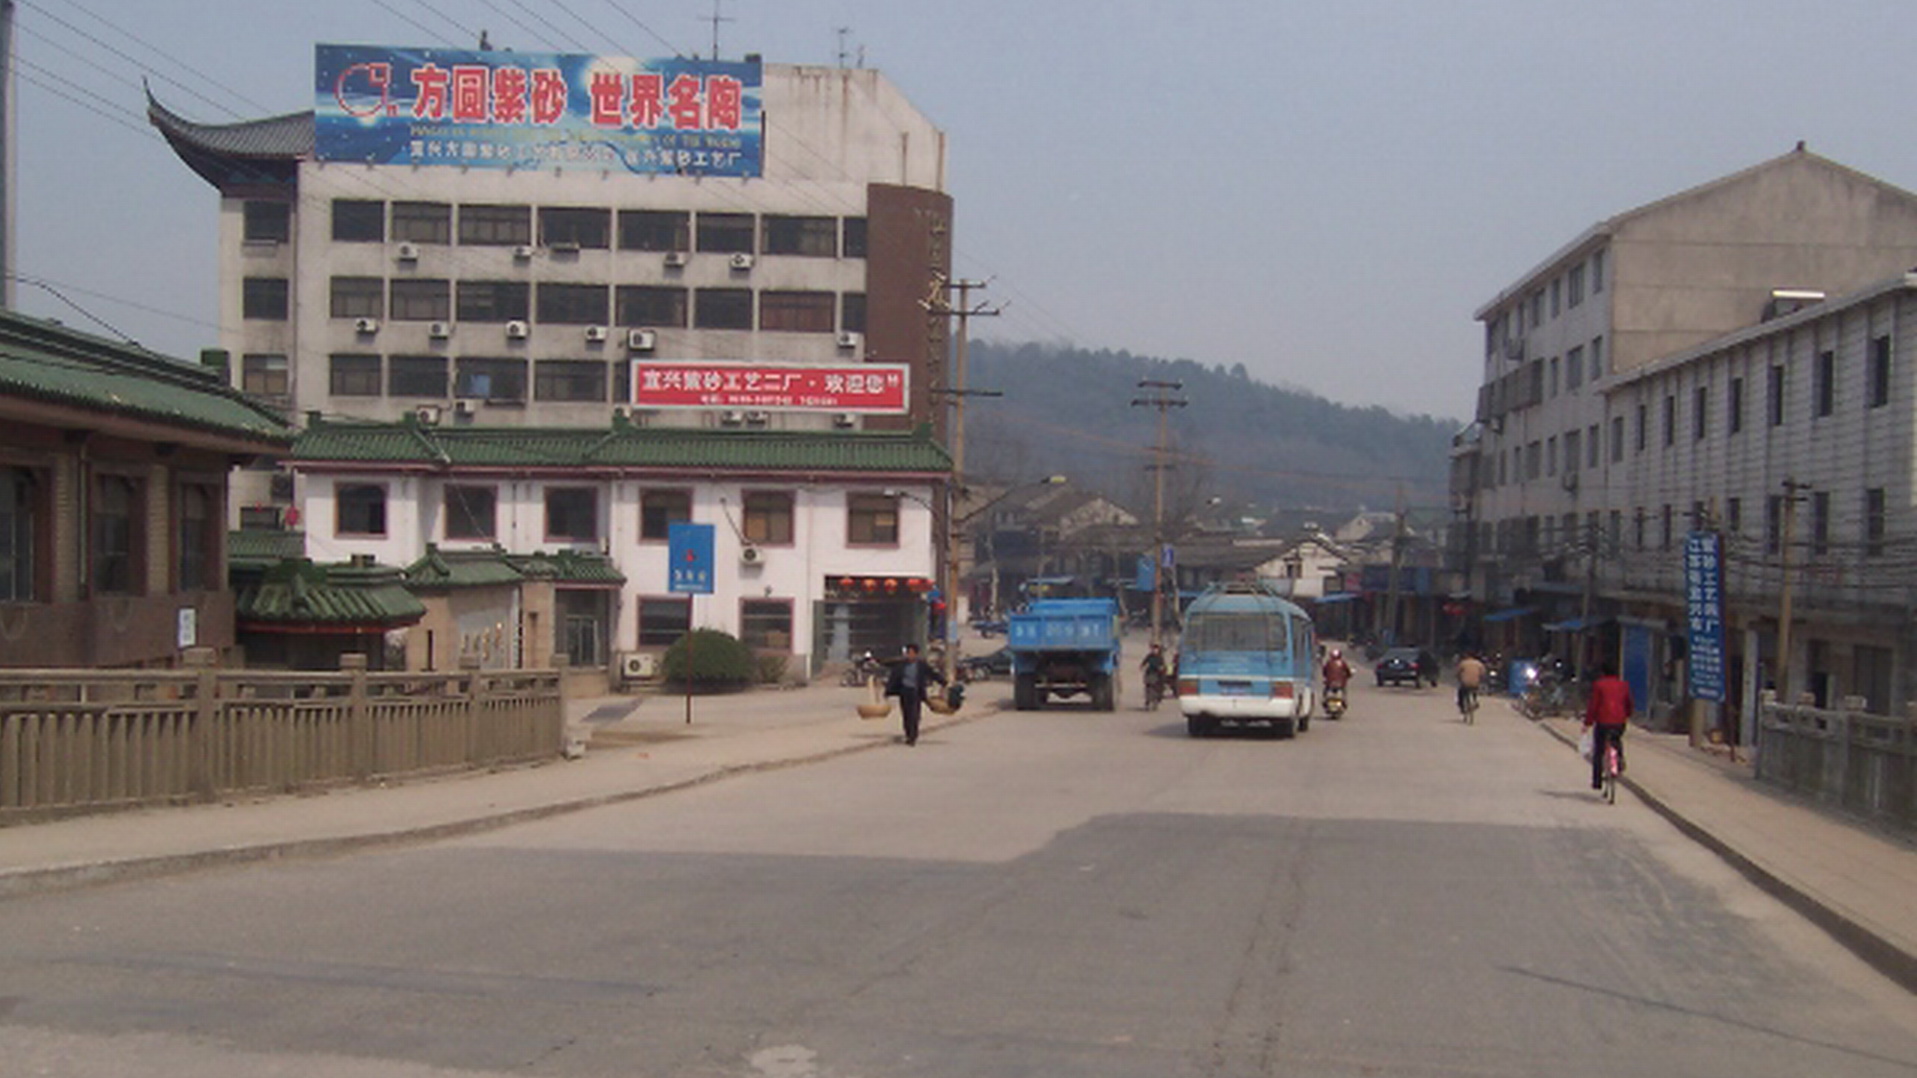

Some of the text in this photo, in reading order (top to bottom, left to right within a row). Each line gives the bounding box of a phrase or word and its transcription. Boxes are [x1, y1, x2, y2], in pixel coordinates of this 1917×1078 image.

[408, 64, 743, 131] 方圆紫砂 世界名陶
